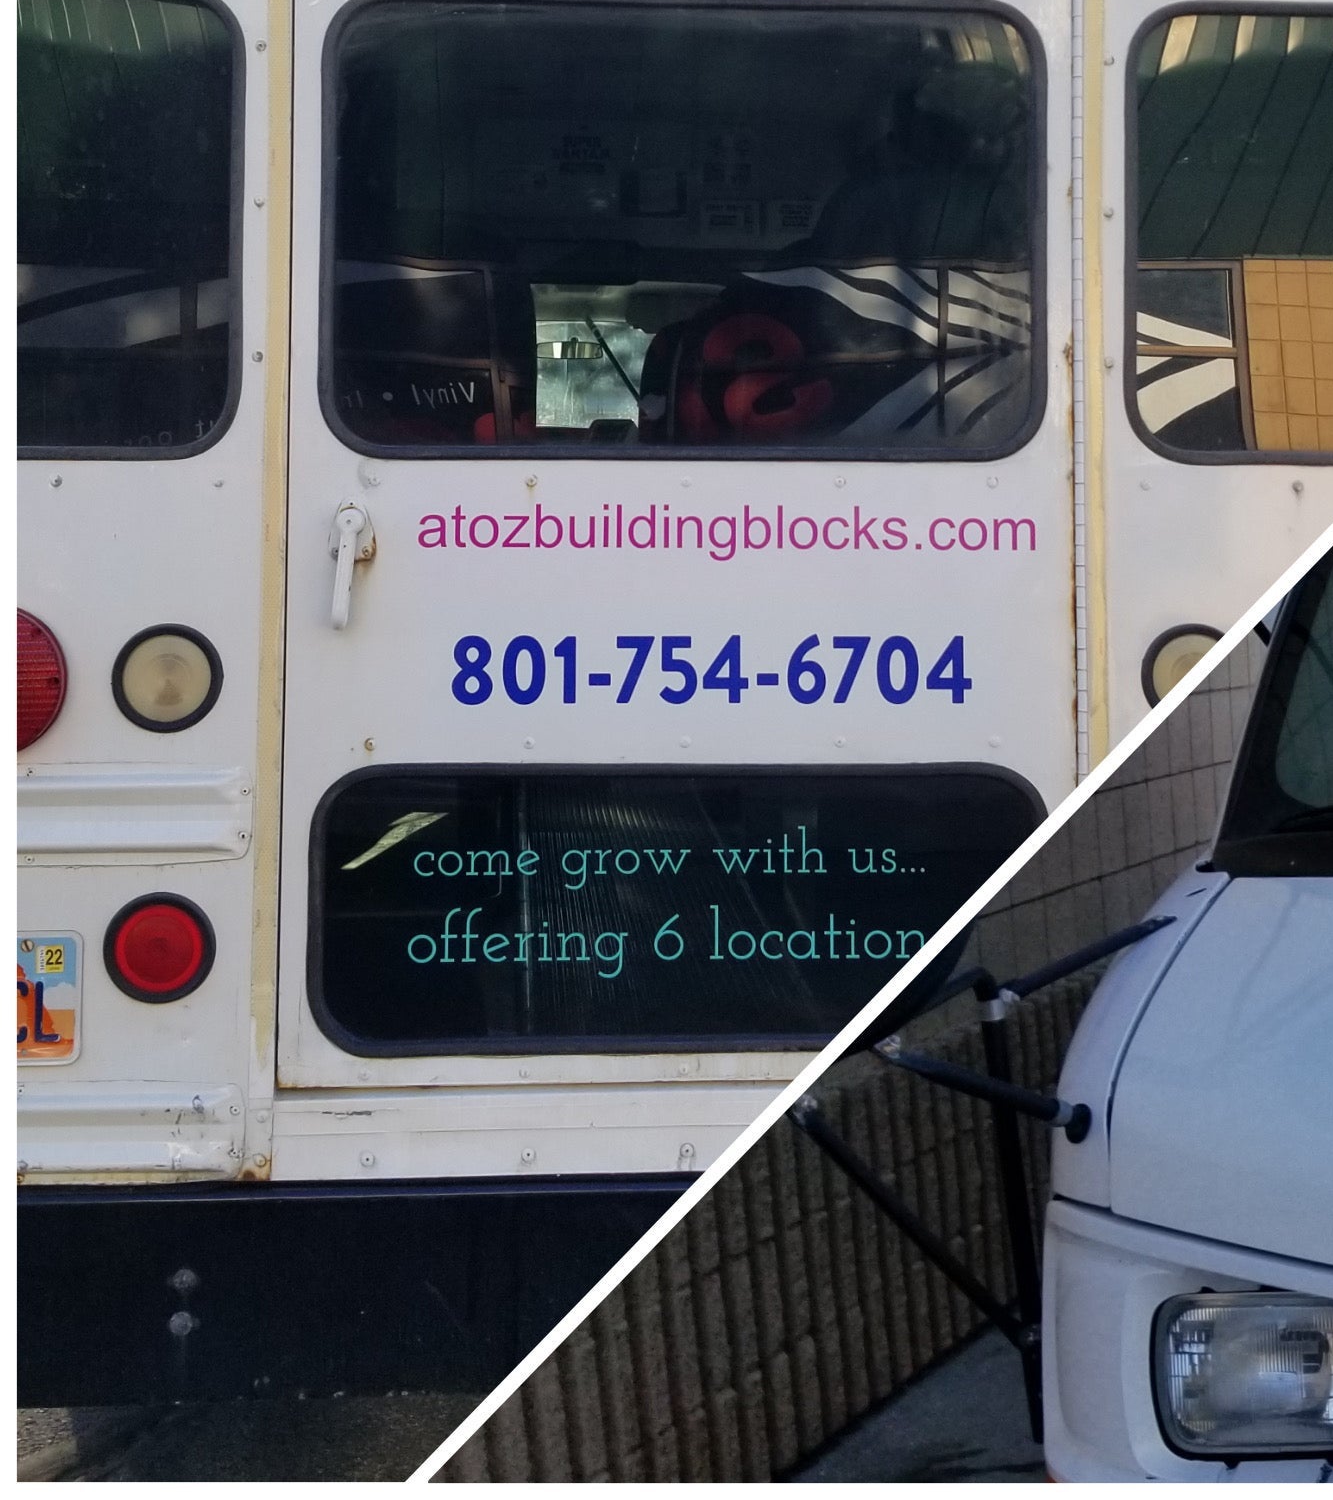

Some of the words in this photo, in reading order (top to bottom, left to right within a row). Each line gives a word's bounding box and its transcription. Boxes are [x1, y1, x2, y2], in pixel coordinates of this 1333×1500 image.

[417, 504, 1036, 561] atozbuildingblocks.com
[451, 634, 973, 705] 801-754-6704
[413, 849, 540, 876] come
[561, 848, 692, 890] grow
[713, 826, 827, 874] with
[848, 847, 926, 874] us...
[45, 949, 63, 965] 22
[408, 907, 628, 979] offering
[653, 913, 684, 961] 6
